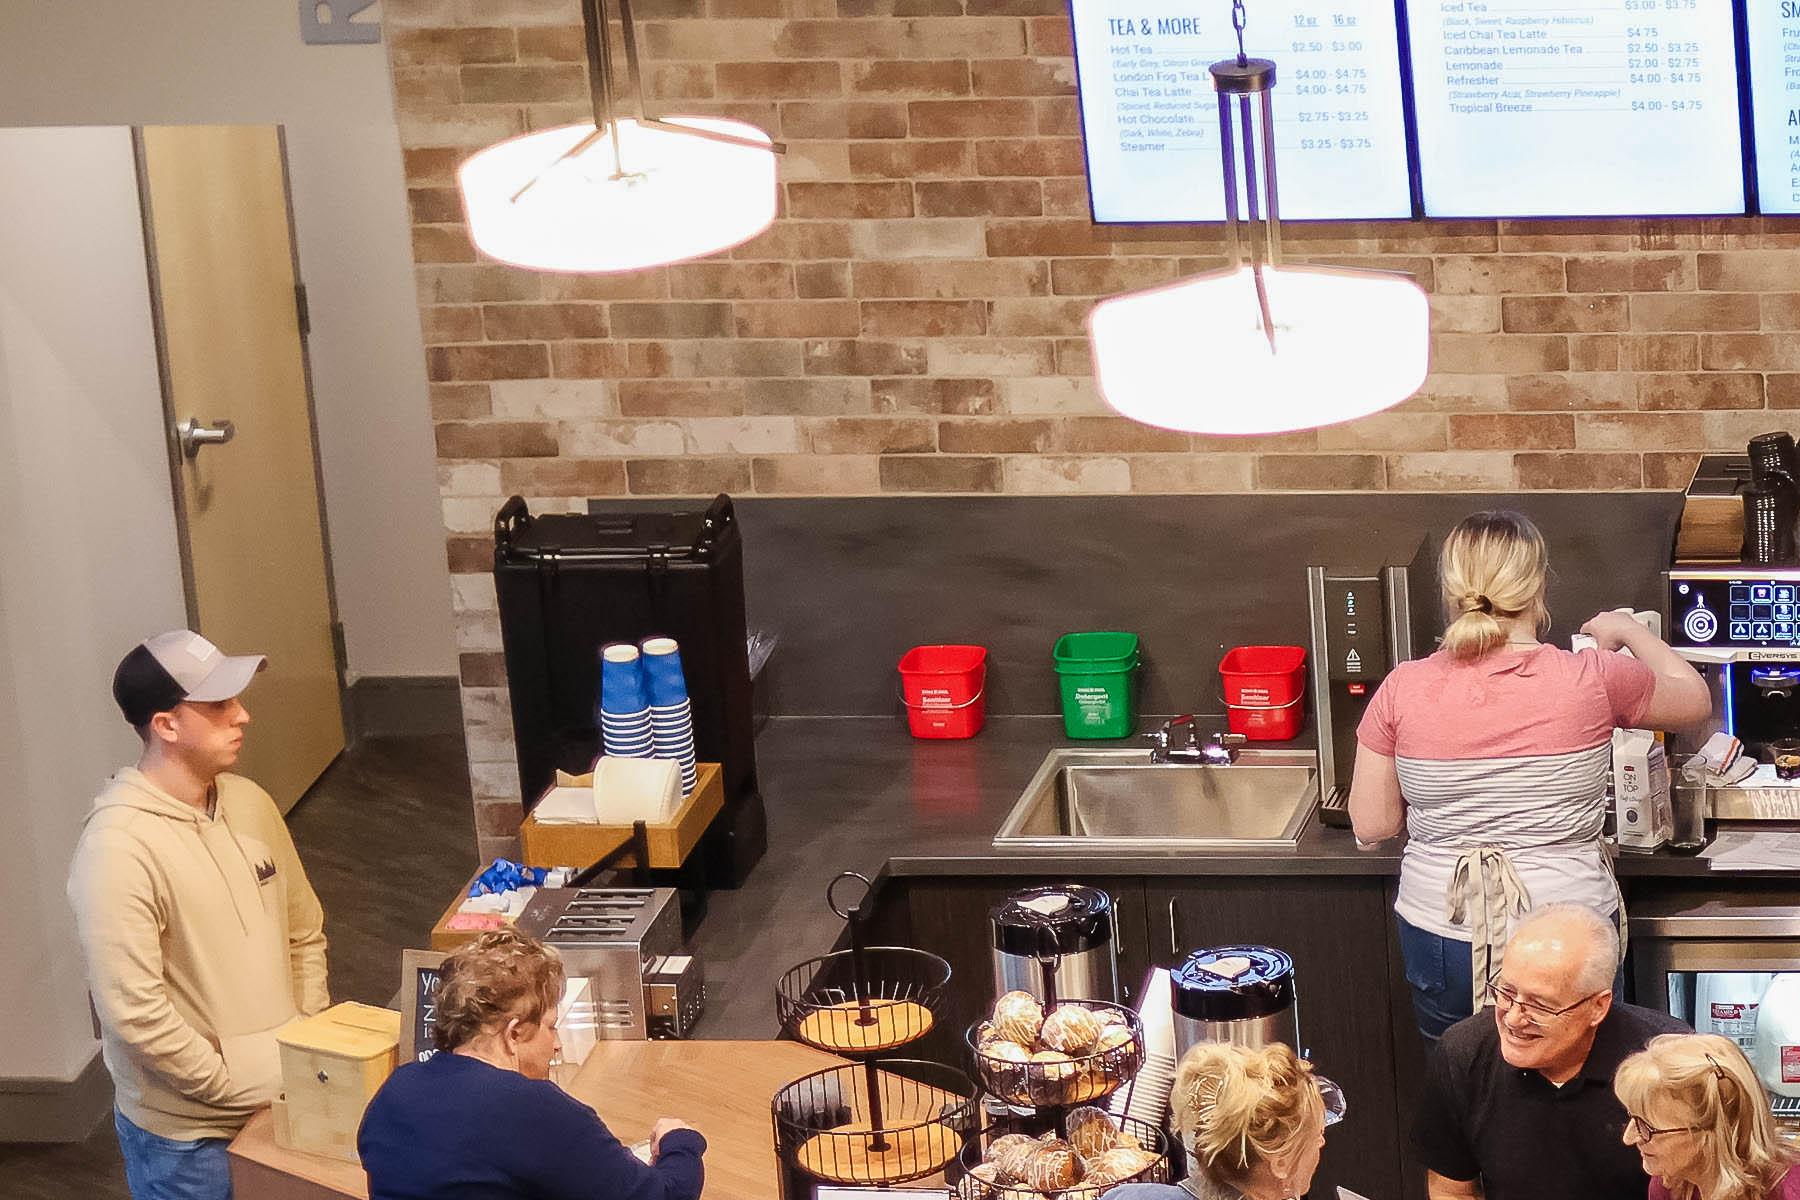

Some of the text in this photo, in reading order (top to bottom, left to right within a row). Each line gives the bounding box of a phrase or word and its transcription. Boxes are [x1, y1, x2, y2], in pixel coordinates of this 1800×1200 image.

[1440, 2, 1463, 12] Iced
[1465, 2, 1487, 12] Tea
[1293, 15, 1305, 25] 12
[1333, 14, 1344, 25] 16
[1108, 18, 1201, 35] TEA & MORE
[1443, 27, 1658, 40] Iced Chai Tea Latte $4.75
[1111, 45, 1130, 55] Hot
[1134, 45, 1153, 55] Tea
[1444, 45, 1499, 56] Caribbean
[1502, 44, 1560, 55] Lemonade
[1563, 44, 1583, 54] Tea
[1446, 60, 1504, 71] Lemonade
[1113, 72, 1154, 82] London
[1157, 72, 1177, 83] Fog
[1180, 71, 1200, 82] Tea
[1296, 69, 1326, 80] $4.00
[1335, 68, 1367, 80] $4.75
[1447, 72, 1702, 85] Refresher $4.00 $4.75
[1115, 84, 1367, 97] Chai Tea Latte $4.00 $4.75
[1449, 100, 1703, 114] Tropical Breeze $4.00 $4.75
[1118, 114, 1137, 124] Hot
[1139, 113, 1195, 124] Chocolate
[1298, 111, 1329, 122] $2.75
[1120, 142, 1165, 152] Steamer
[1623, 784, 1639, 793] TOP
